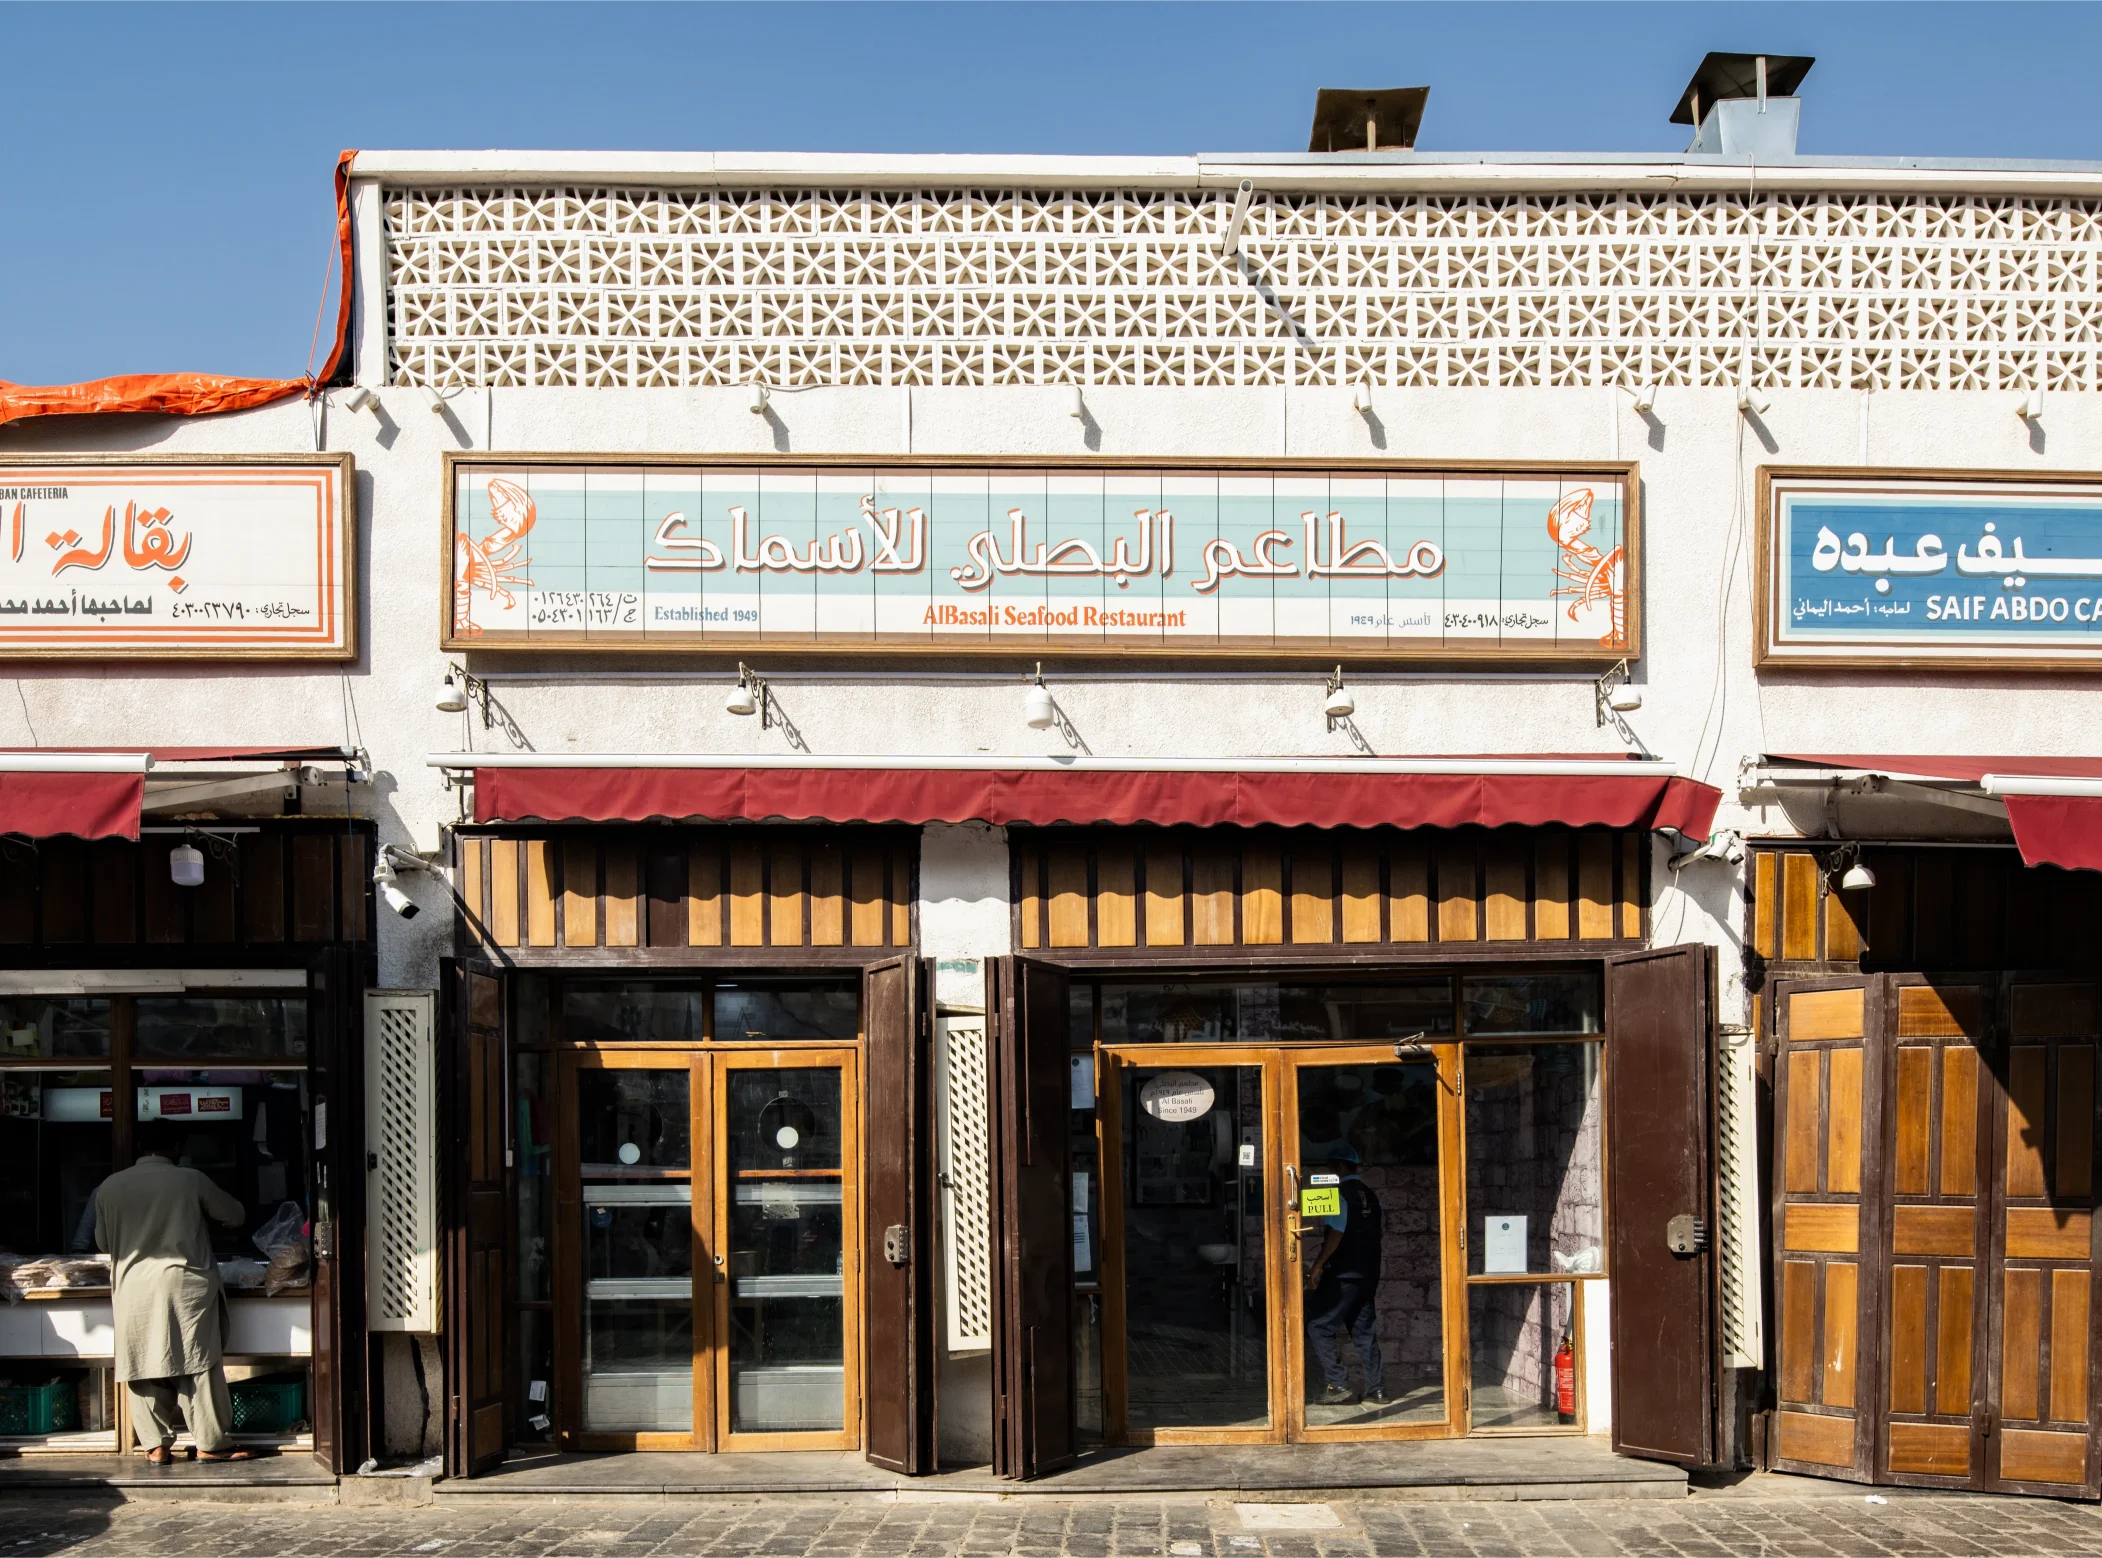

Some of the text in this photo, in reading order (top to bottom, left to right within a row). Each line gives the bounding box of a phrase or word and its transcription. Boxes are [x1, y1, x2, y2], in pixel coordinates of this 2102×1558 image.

[20, 487, 69, 500] CAFETERIA
[44, 499, 192, 594] بقالة
[645, 494, 1447, 595] مطاعم البصلي للأسماك
[1812, 525, 1948, 596] عبده
[32, 588, 76, 616] أحمد
[81, 594, 152, 623] لصاحبها
[282, 602, 310, 619] سجل
[1793, 598, 1832, 620] اليماني
[1834, 597, 1870, 617] أحمد
[1926, 595, 1986, 622] SAIF
[1990, 596, 2070, 622] ABDO
[654, 606, 758, 622] Established 1949
[923, 604, 1187, 627] AlBasali Seafood Restaurant
[1350, 612, 1431, 628] تأسس عام ١٩٤٩
[1525, 614, 1549, 629] سجل
[1308, 1205, 1334, 1213] PULL
